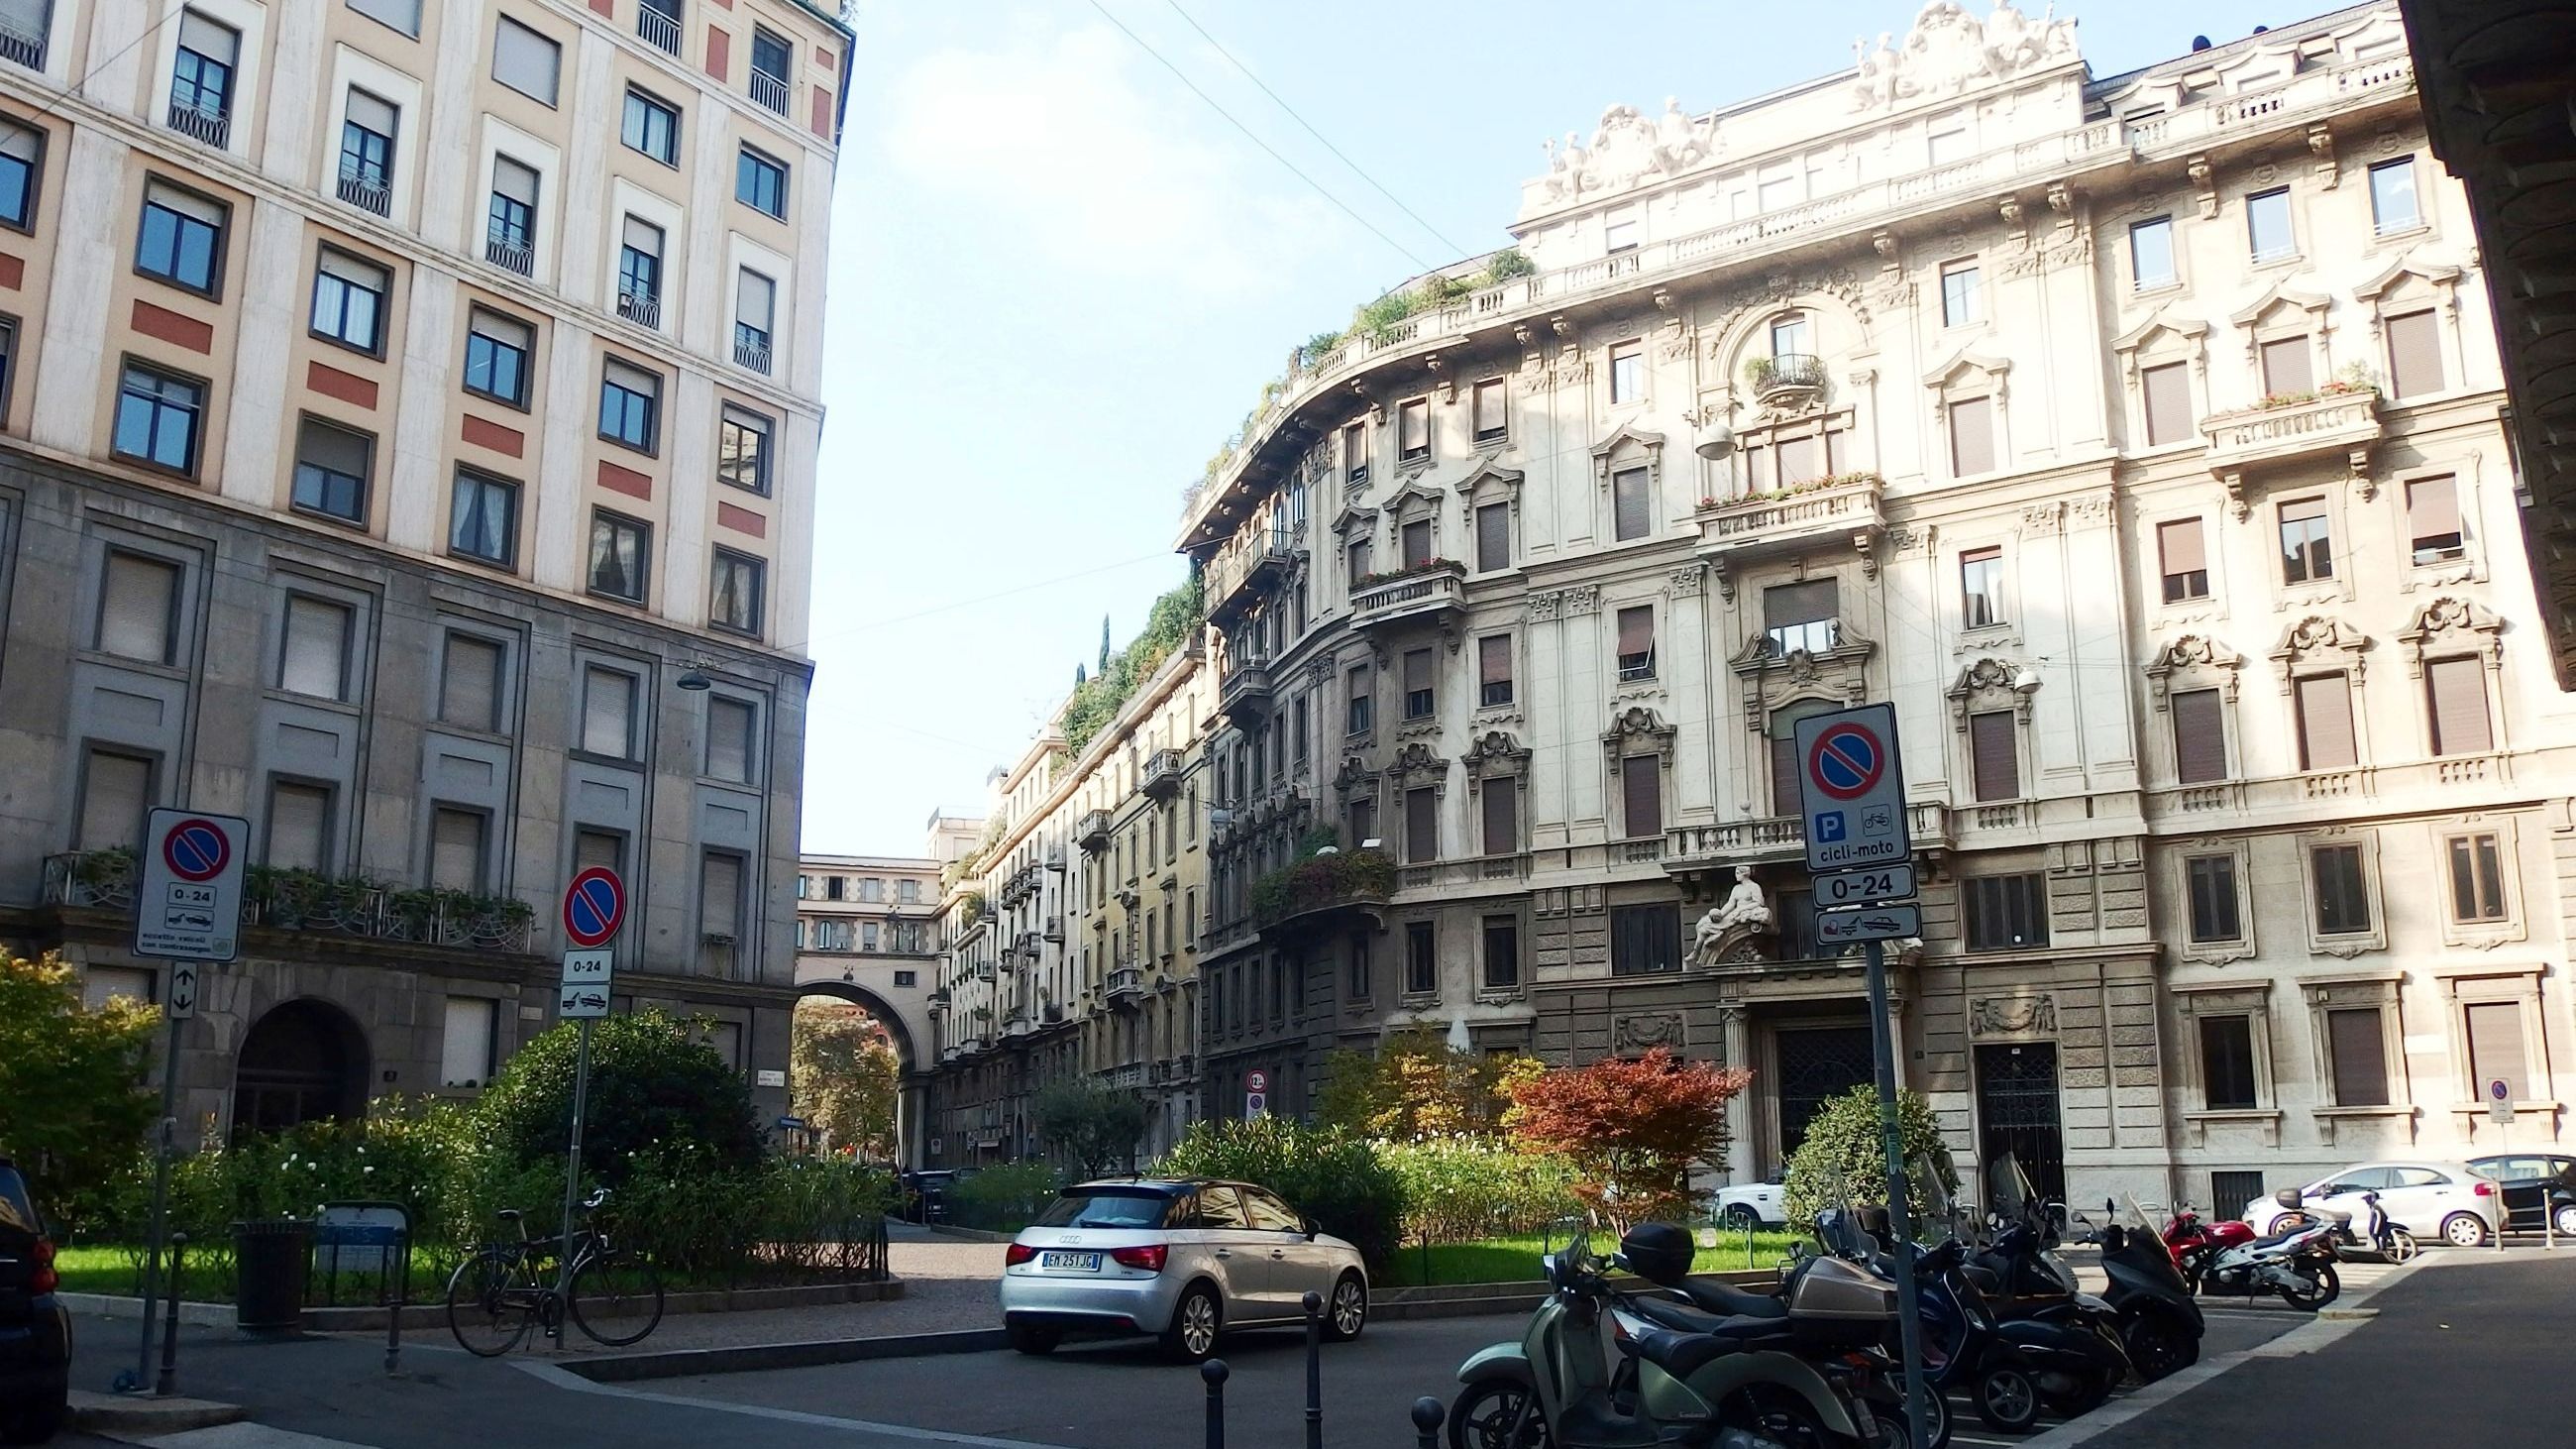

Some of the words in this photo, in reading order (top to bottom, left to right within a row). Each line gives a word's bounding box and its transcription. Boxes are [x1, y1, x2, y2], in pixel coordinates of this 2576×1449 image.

[1822, 816, 1839, 838] P
[1820, 840, 1893, 862] cicli-moto
[1831, 873, 1893, 899] 0-24
[174, 889, 210, 902] 0-24
[574, 960, 601, 972] 0-24
[1049, 1254, 1060, 1267] EM
